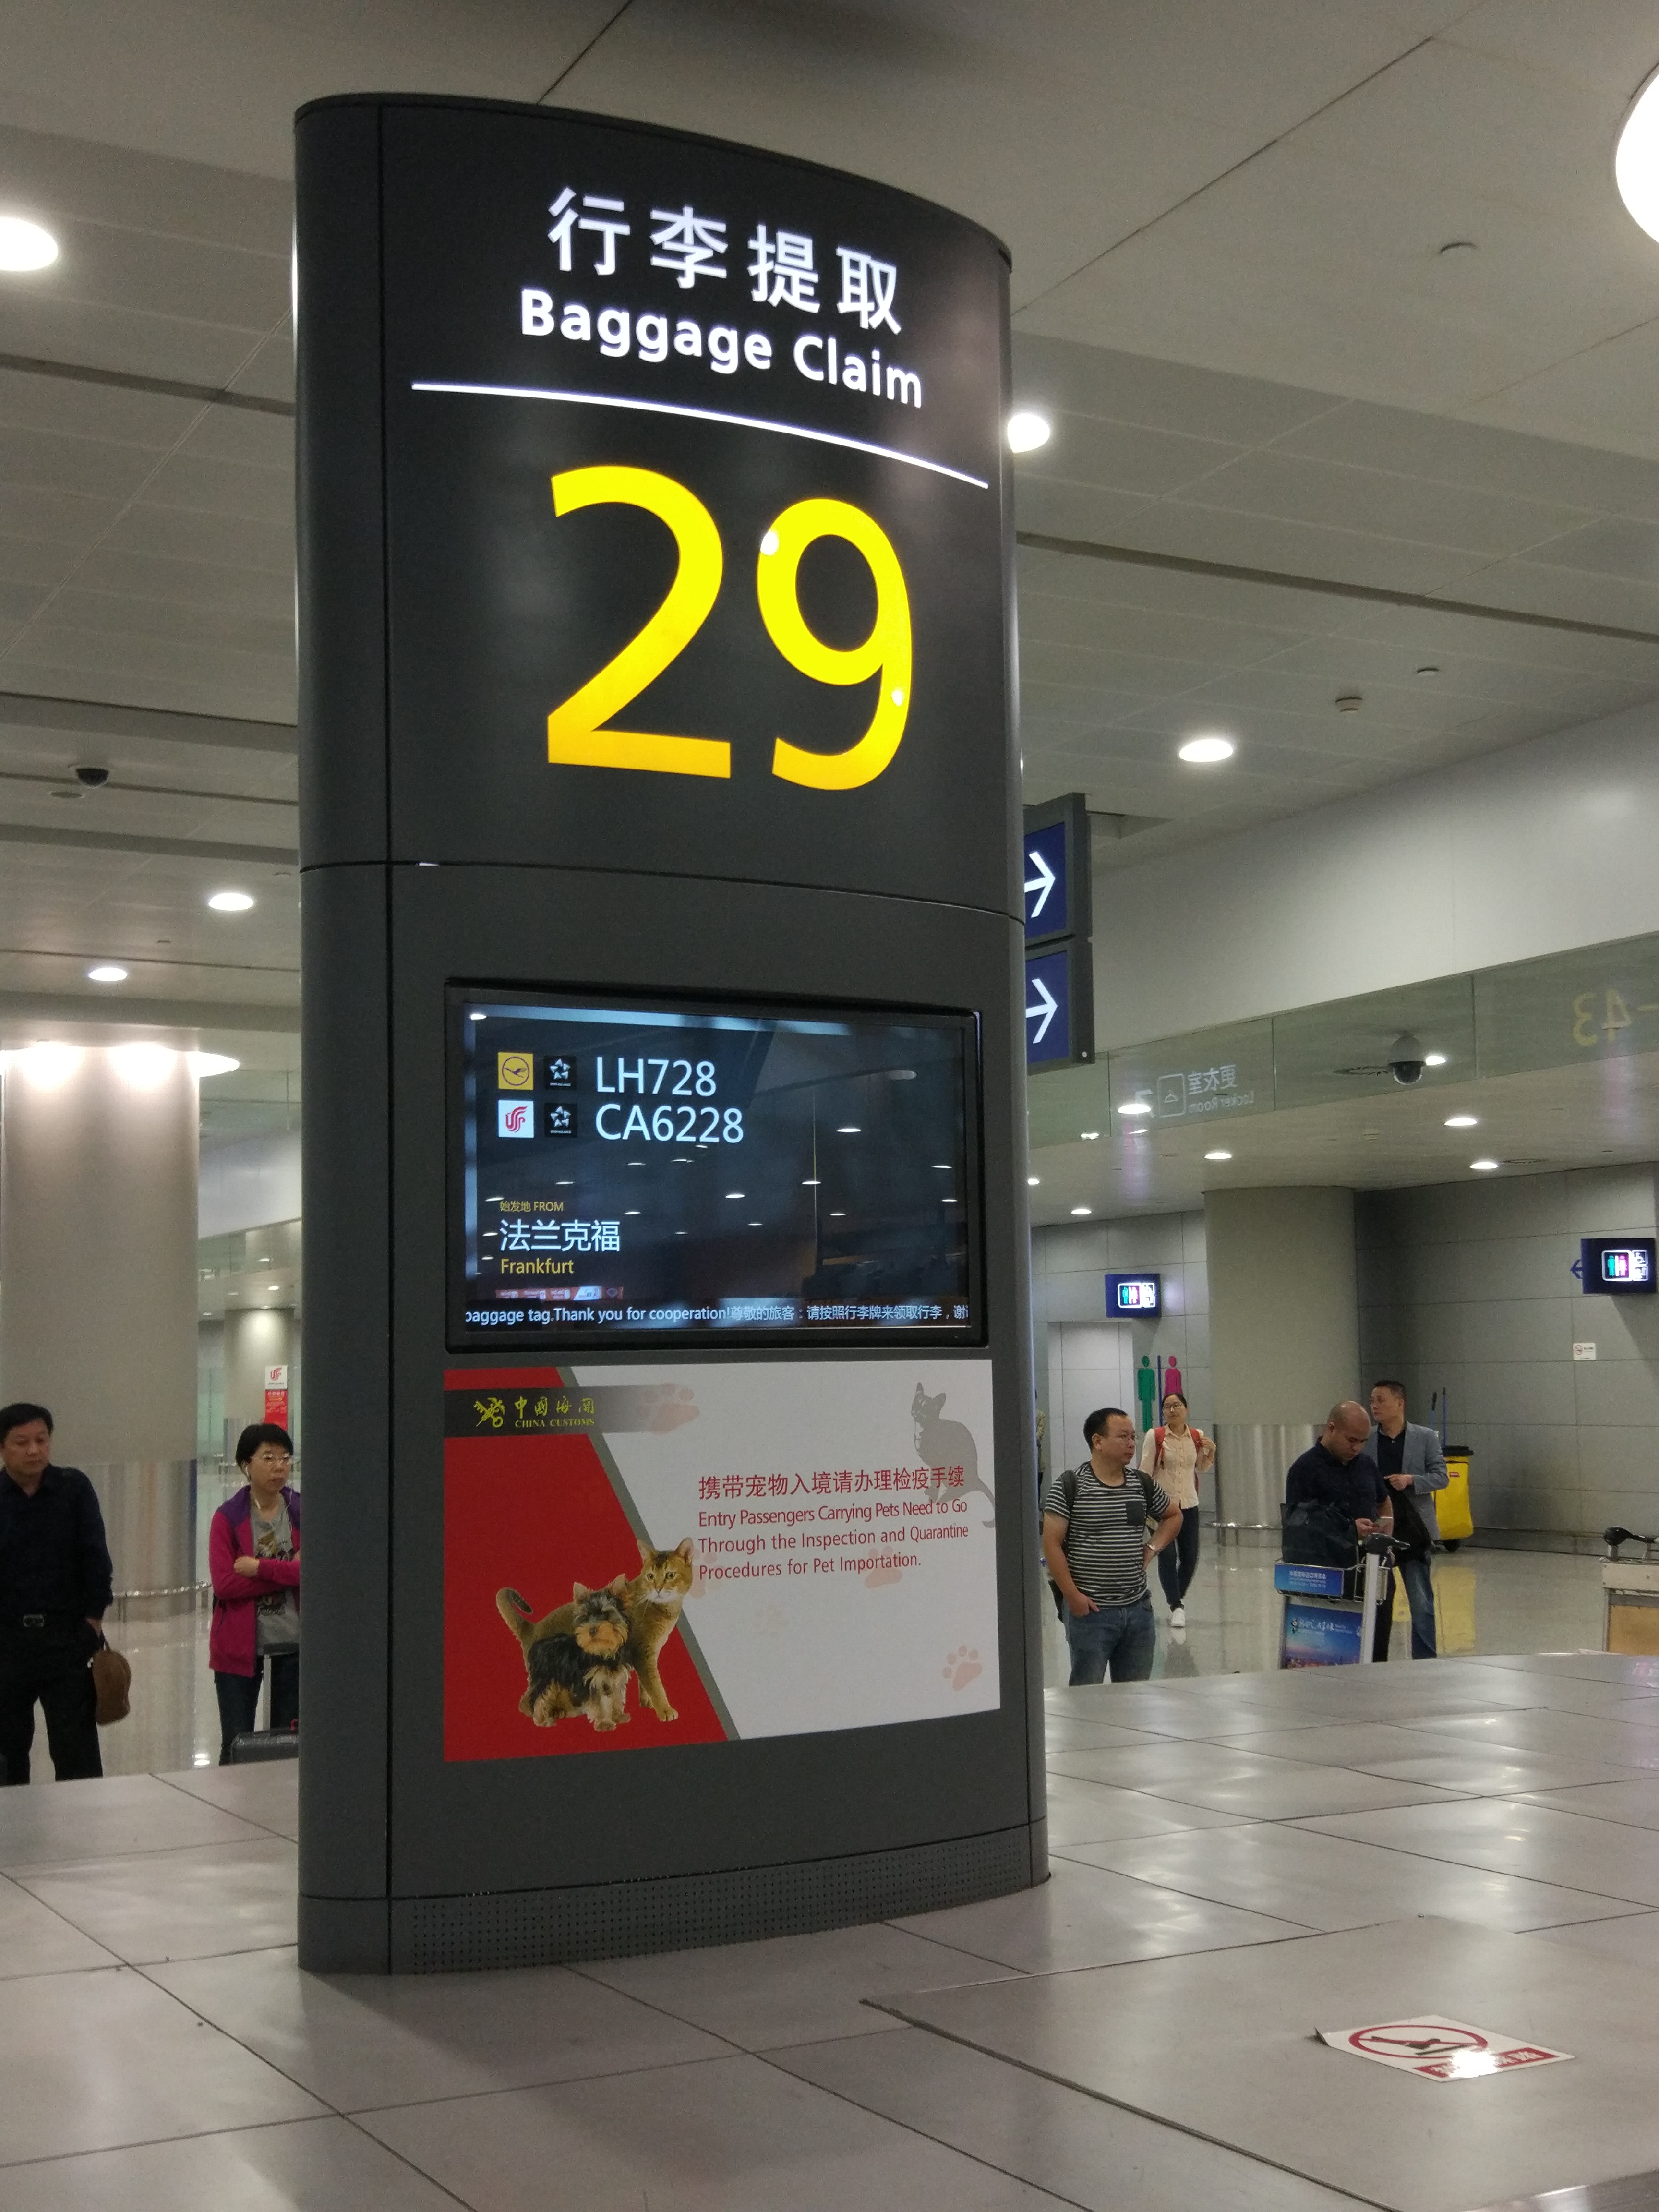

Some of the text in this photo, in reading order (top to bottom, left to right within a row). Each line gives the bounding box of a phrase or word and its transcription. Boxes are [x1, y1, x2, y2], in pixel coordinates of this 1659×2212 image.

[548, 186, 902, 335] 行李提取
[521, 289, 922, 408] Baggage Claim
[547, 465, 912, 790] 29
[596, 1057, 716, 1097] LH728
[596, 1104, 744, 1143] CA6228
[500, 1201, 564, 1212] 始发地 FROM
[500, 1218, 620, 1252] 法兰克福
[501, 1258, 574, 1274] Frankfurt
[598, 1310, 623, 1324] you
[626, 1306, 646, 1320] for
[515, 1418, 595, 1428] CHINA CUSTOMS
[698, 1465, 964, 1500] 携带宠物入境请办理检疫手续
[699, 1498, 968, 1528] Entry Passengers Carrying Pets Need to Go
[698, 1523, 969, 1555] Through the Inspection and Quarantine
[699, 1552, 922, 1581] Procedures for Pet Importation.
